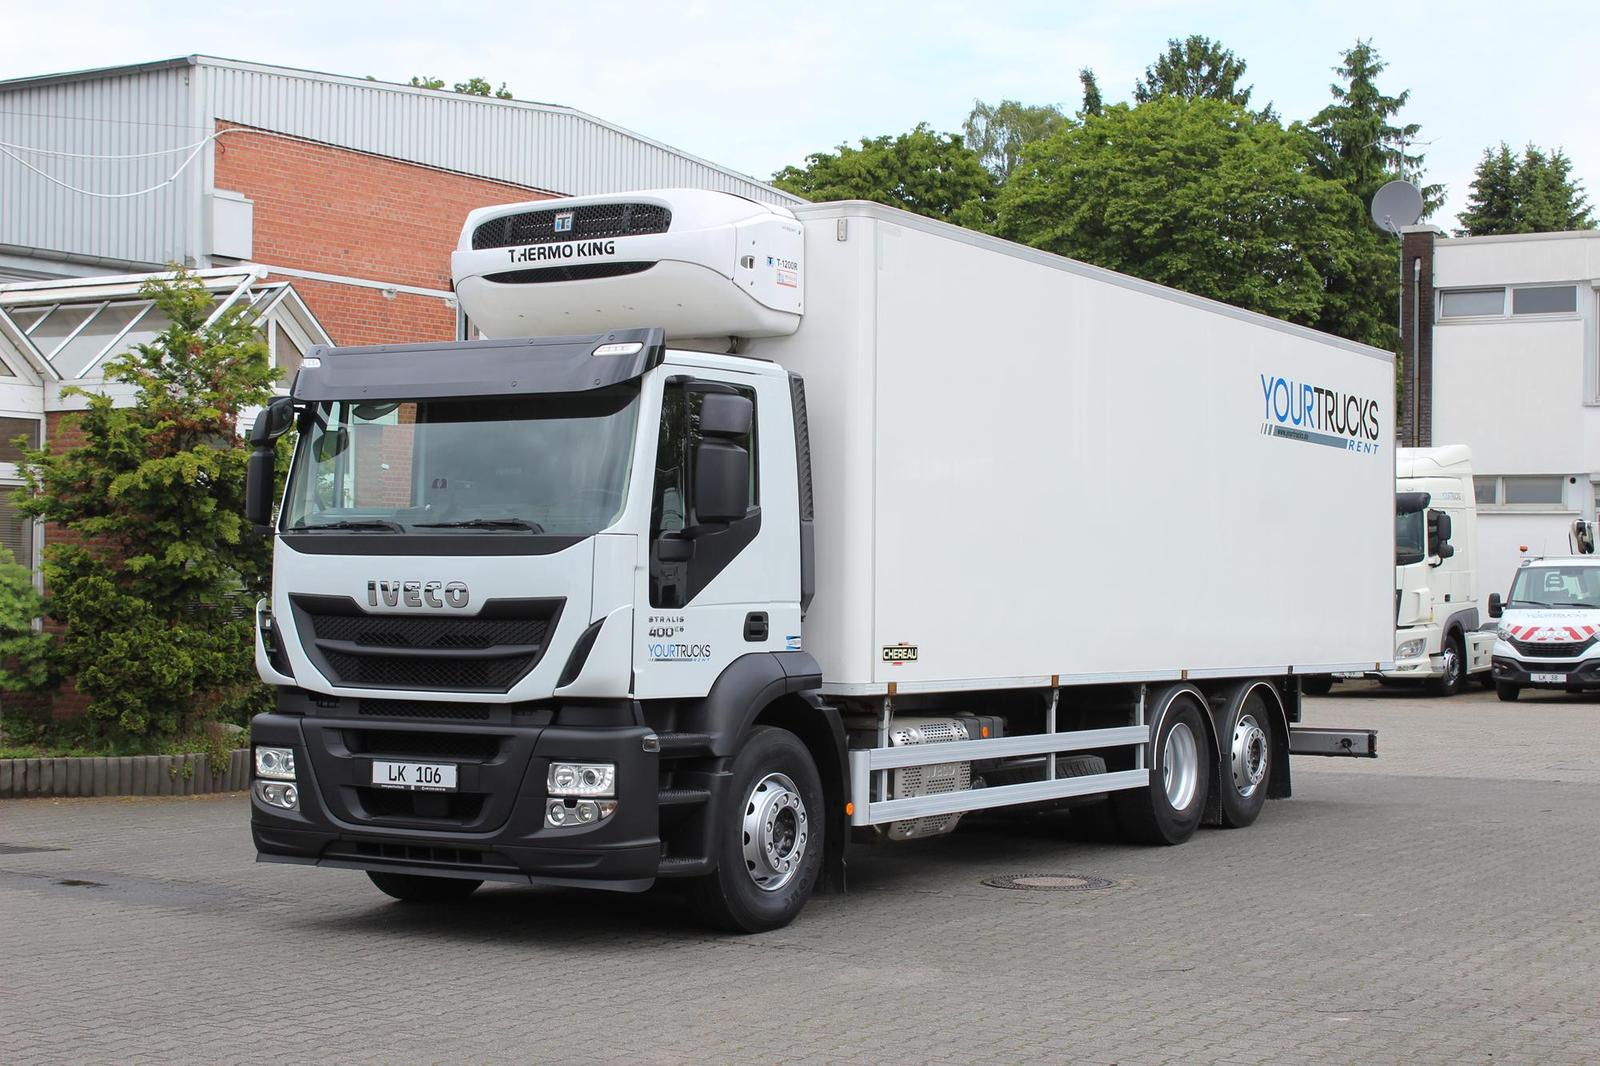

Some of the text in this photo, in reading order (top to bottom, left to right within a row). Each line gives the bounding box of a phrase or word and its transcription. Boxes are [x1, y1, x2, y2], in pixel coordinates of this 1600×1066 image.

[508, 240, 615, 263] THERMO KING
[777, 258, 798, 271] T-1200R
[1260, 373, 1379, 441] YOURTRUCKS
[1348, 439, 1380, 455] RENT
[367, 580, 470, 609] IVECO
[648, 644, 711, 658] YOURTRUCKS
[883, 646, 918, 660] CHEREAU
[388, 764, 441, 784] LK 106
